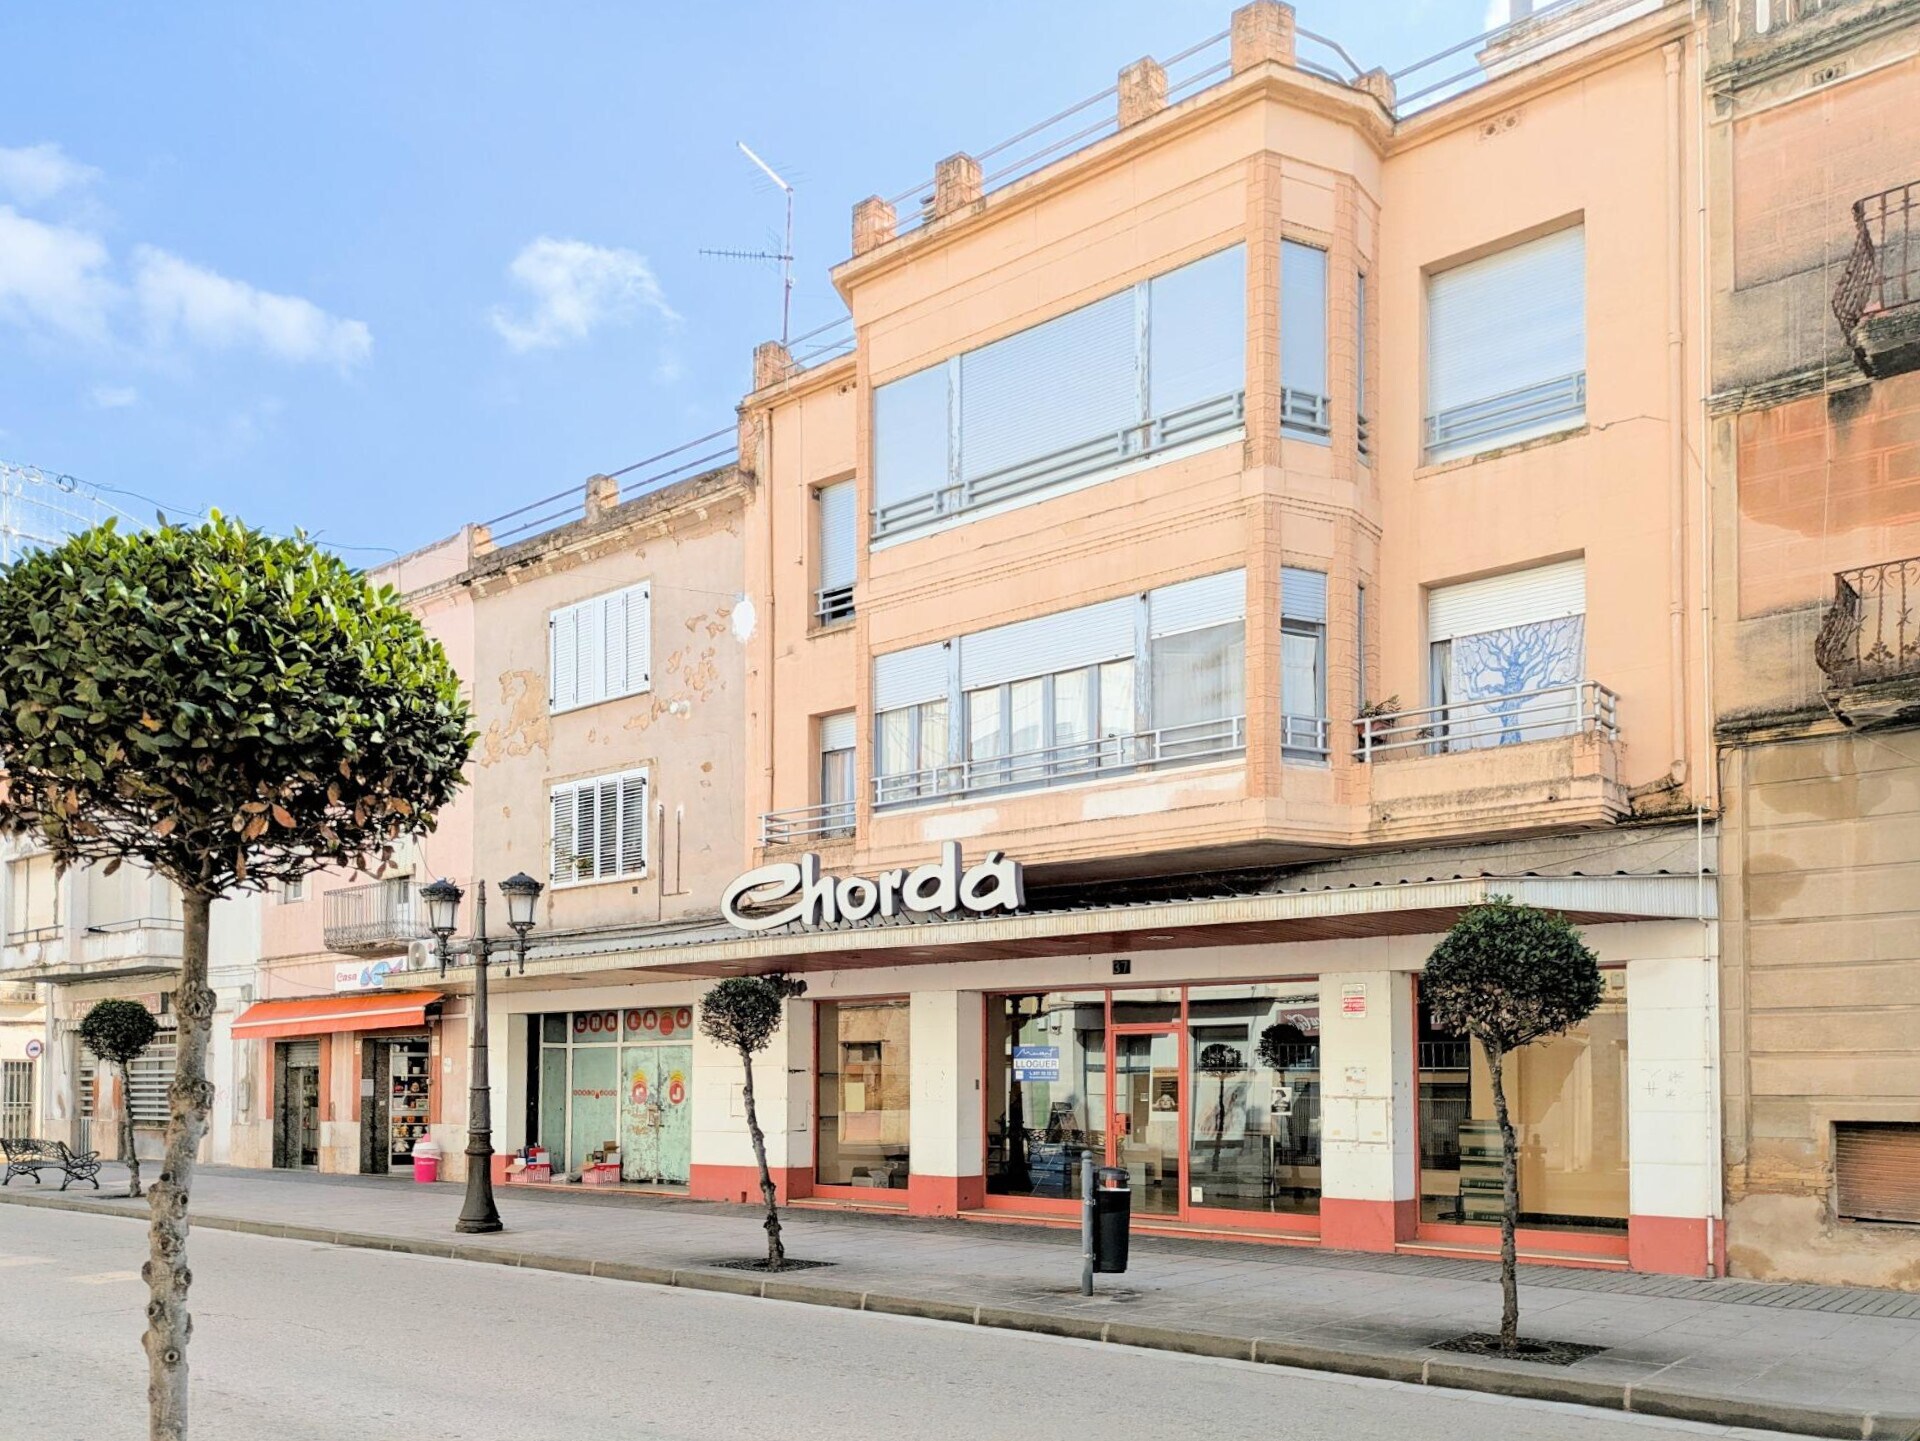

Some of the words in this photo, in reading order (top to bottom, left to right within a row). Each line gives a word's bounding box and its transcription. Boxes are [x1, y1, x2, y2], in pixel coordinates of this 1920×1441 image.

[720, 841, 1021, 930] Chordá
[1114, 961, 1127, 974] 37
[336, 972, 357, 982] Casa
[1016, 1060, 1057, 1068] LLOGUER
